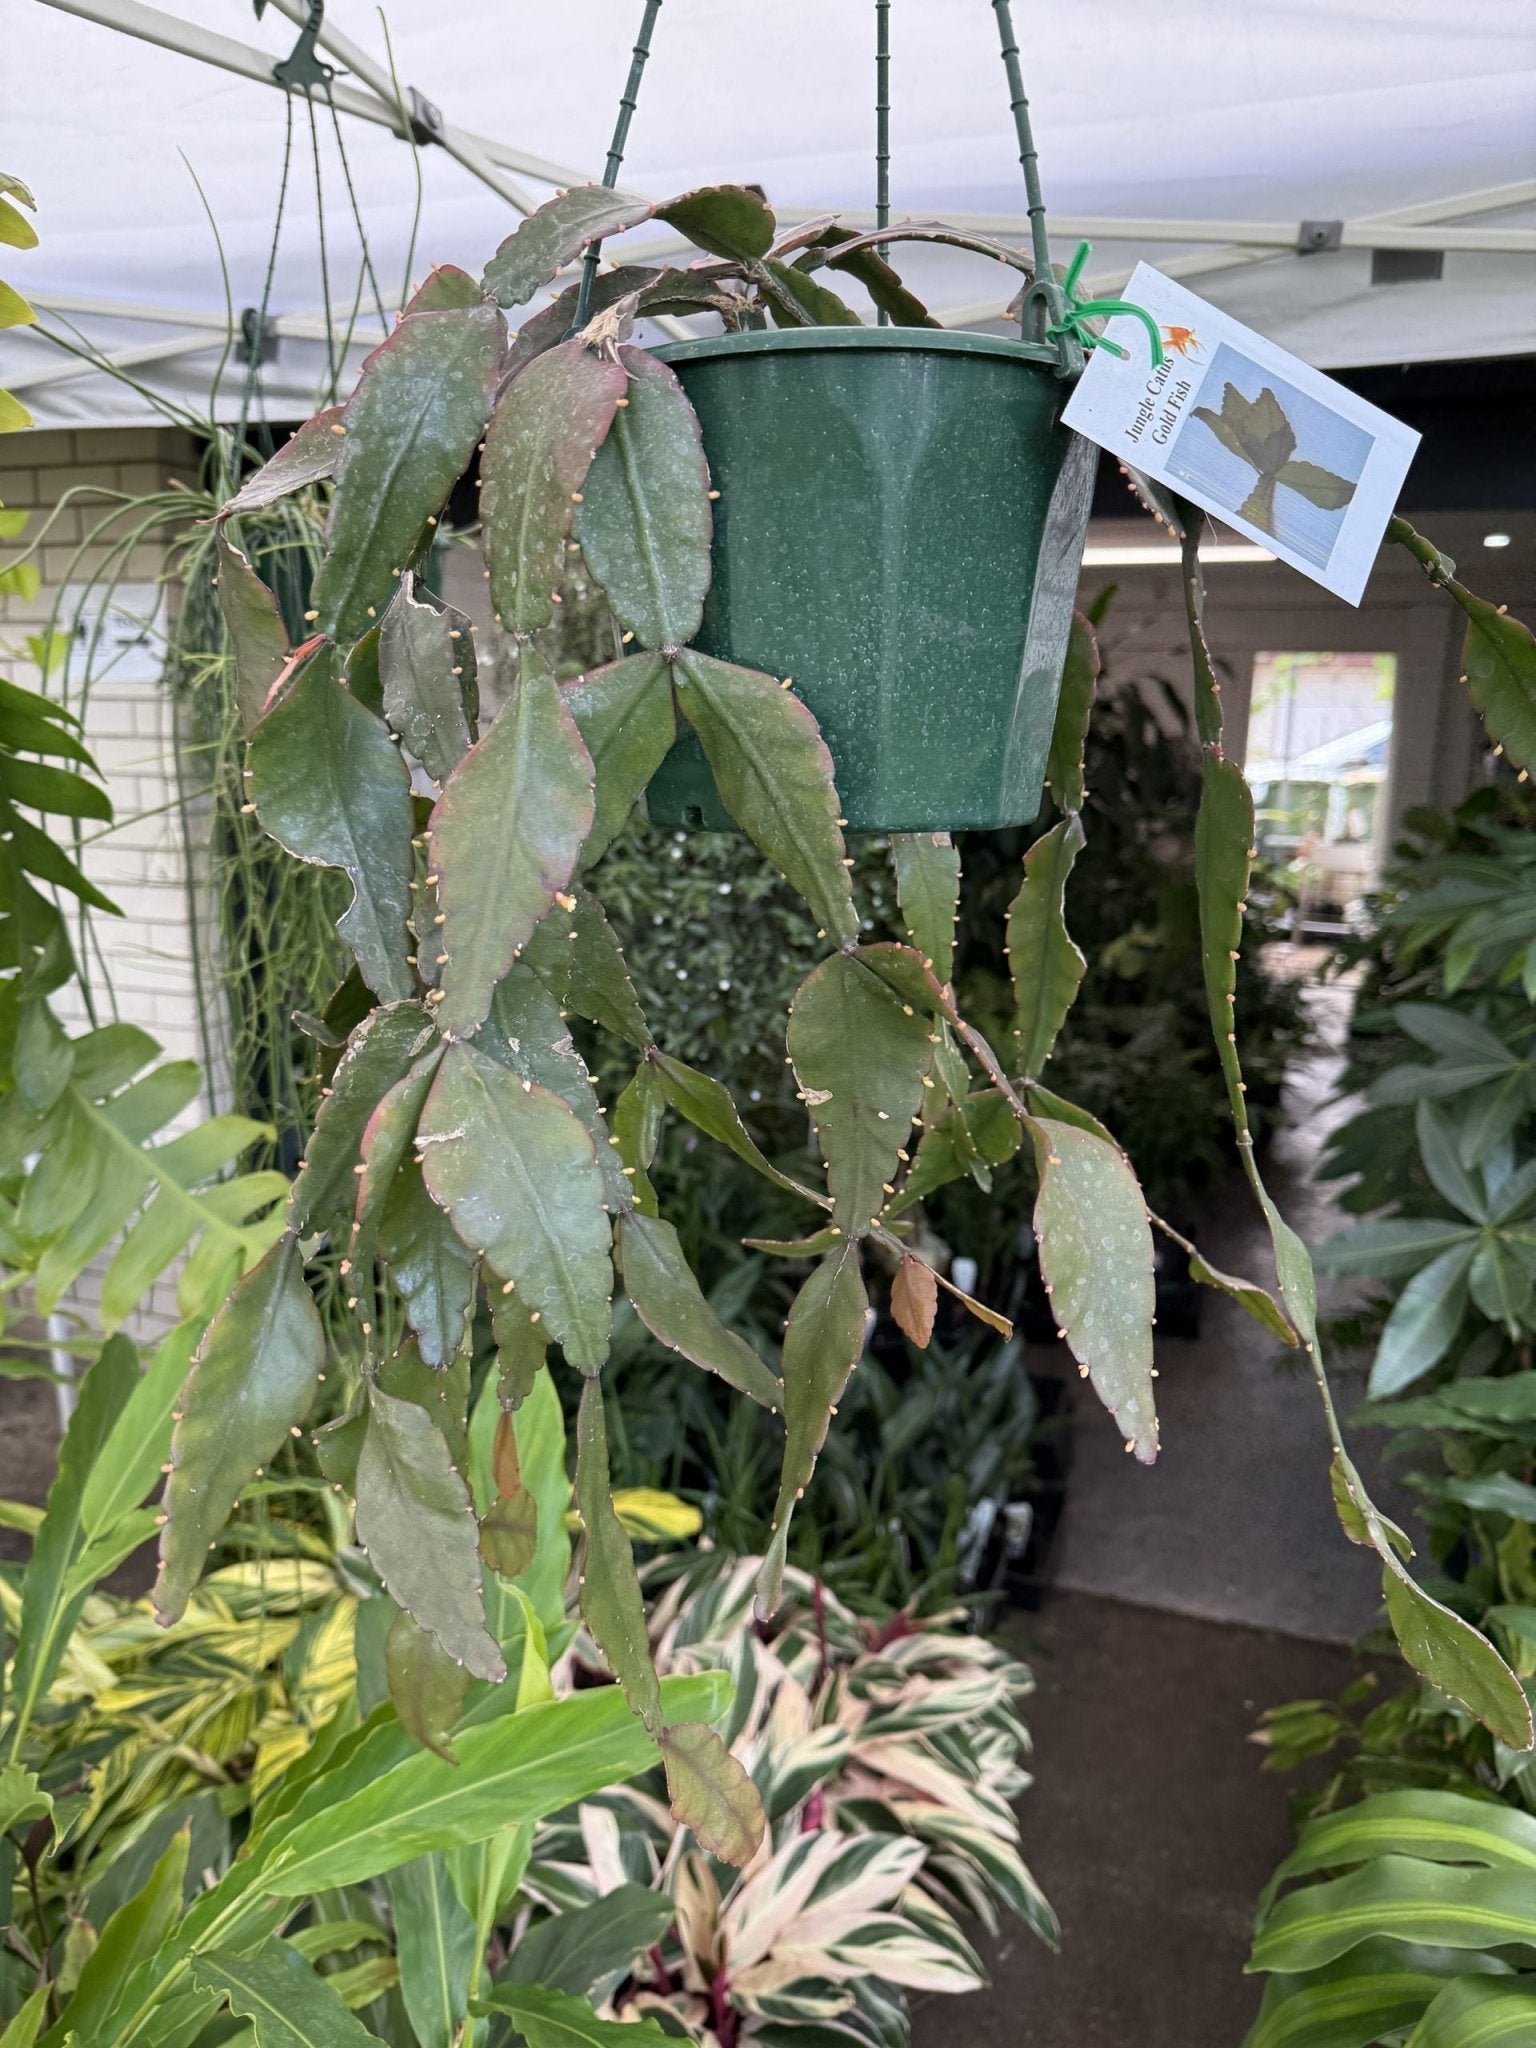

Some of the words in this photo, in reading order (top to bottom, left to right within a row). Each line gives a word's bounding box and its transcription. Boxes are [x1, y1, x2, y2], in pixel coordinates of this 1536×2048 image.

[1124, 397, 1156, 443] Jungle
[1146, 356, 1175, 395] Catus
[1151, 409, 1177, 445] Gold
[1167, 380, 1192, 410] Fish
